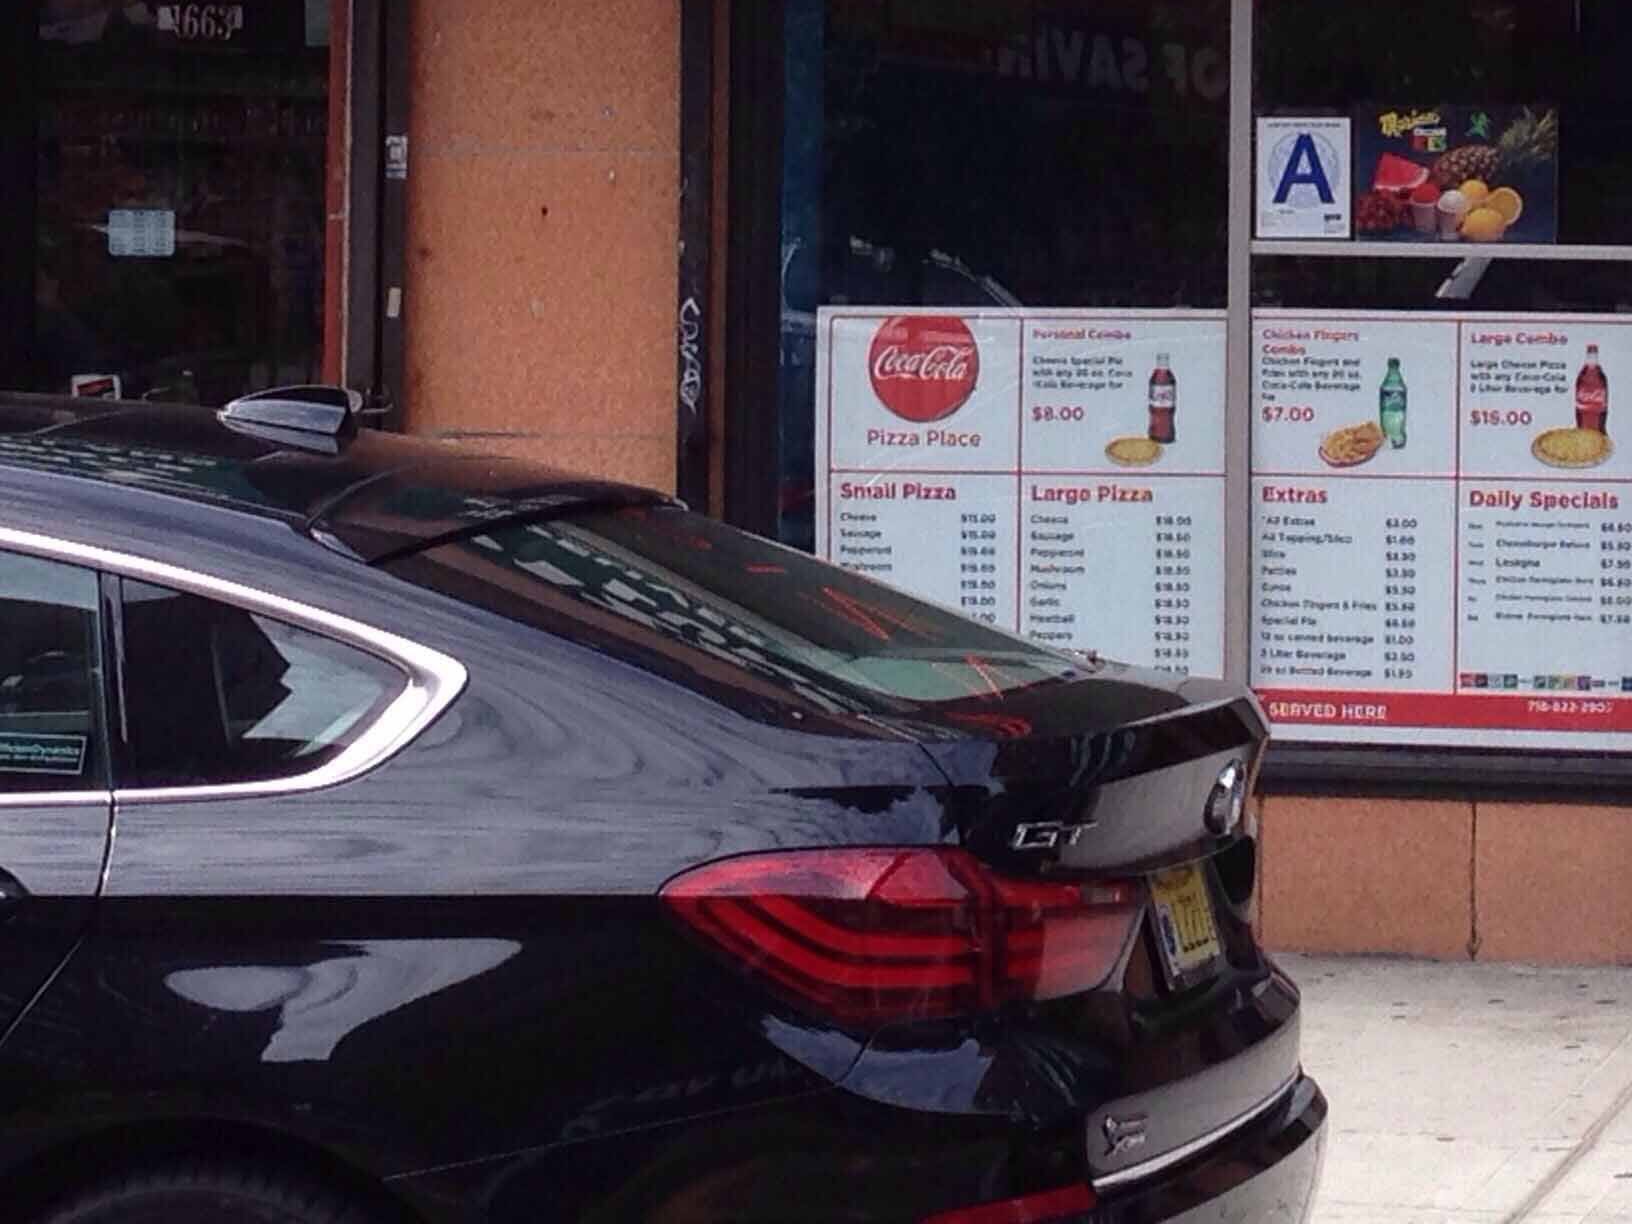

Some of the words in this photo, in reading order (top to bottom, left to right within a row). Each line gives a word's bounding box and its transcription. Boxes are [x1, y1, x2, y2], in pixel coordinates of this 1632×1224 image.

[1273, 133, 1336, 205] A
[1471, 332, 1512, 346] Large
[1516, 332, 1568, 345] Combo
[1032, 406, 1084, 421] $8.00
[1262, 406, 1315, 421] $7.00
[867, 429, 920, 446] Pizza
[926, 430, 981, 447] Place
[840, 482, 896, 499] Small
[902, 483, 957, 500] Pizza
[1031, 485, 1091, 505] Large
[1097, 485, 1153, 503] Pizza
[1262, 486, 1328, 503] Extras
[1469, 490, 1522, 510] Daily
[1530, 491, 1619, 511] Specials
[1269, 702, 1337, 718] SERVED
[1341, 704, 1387, 720] HERE
[1013, 821, 1098, 848] GT
